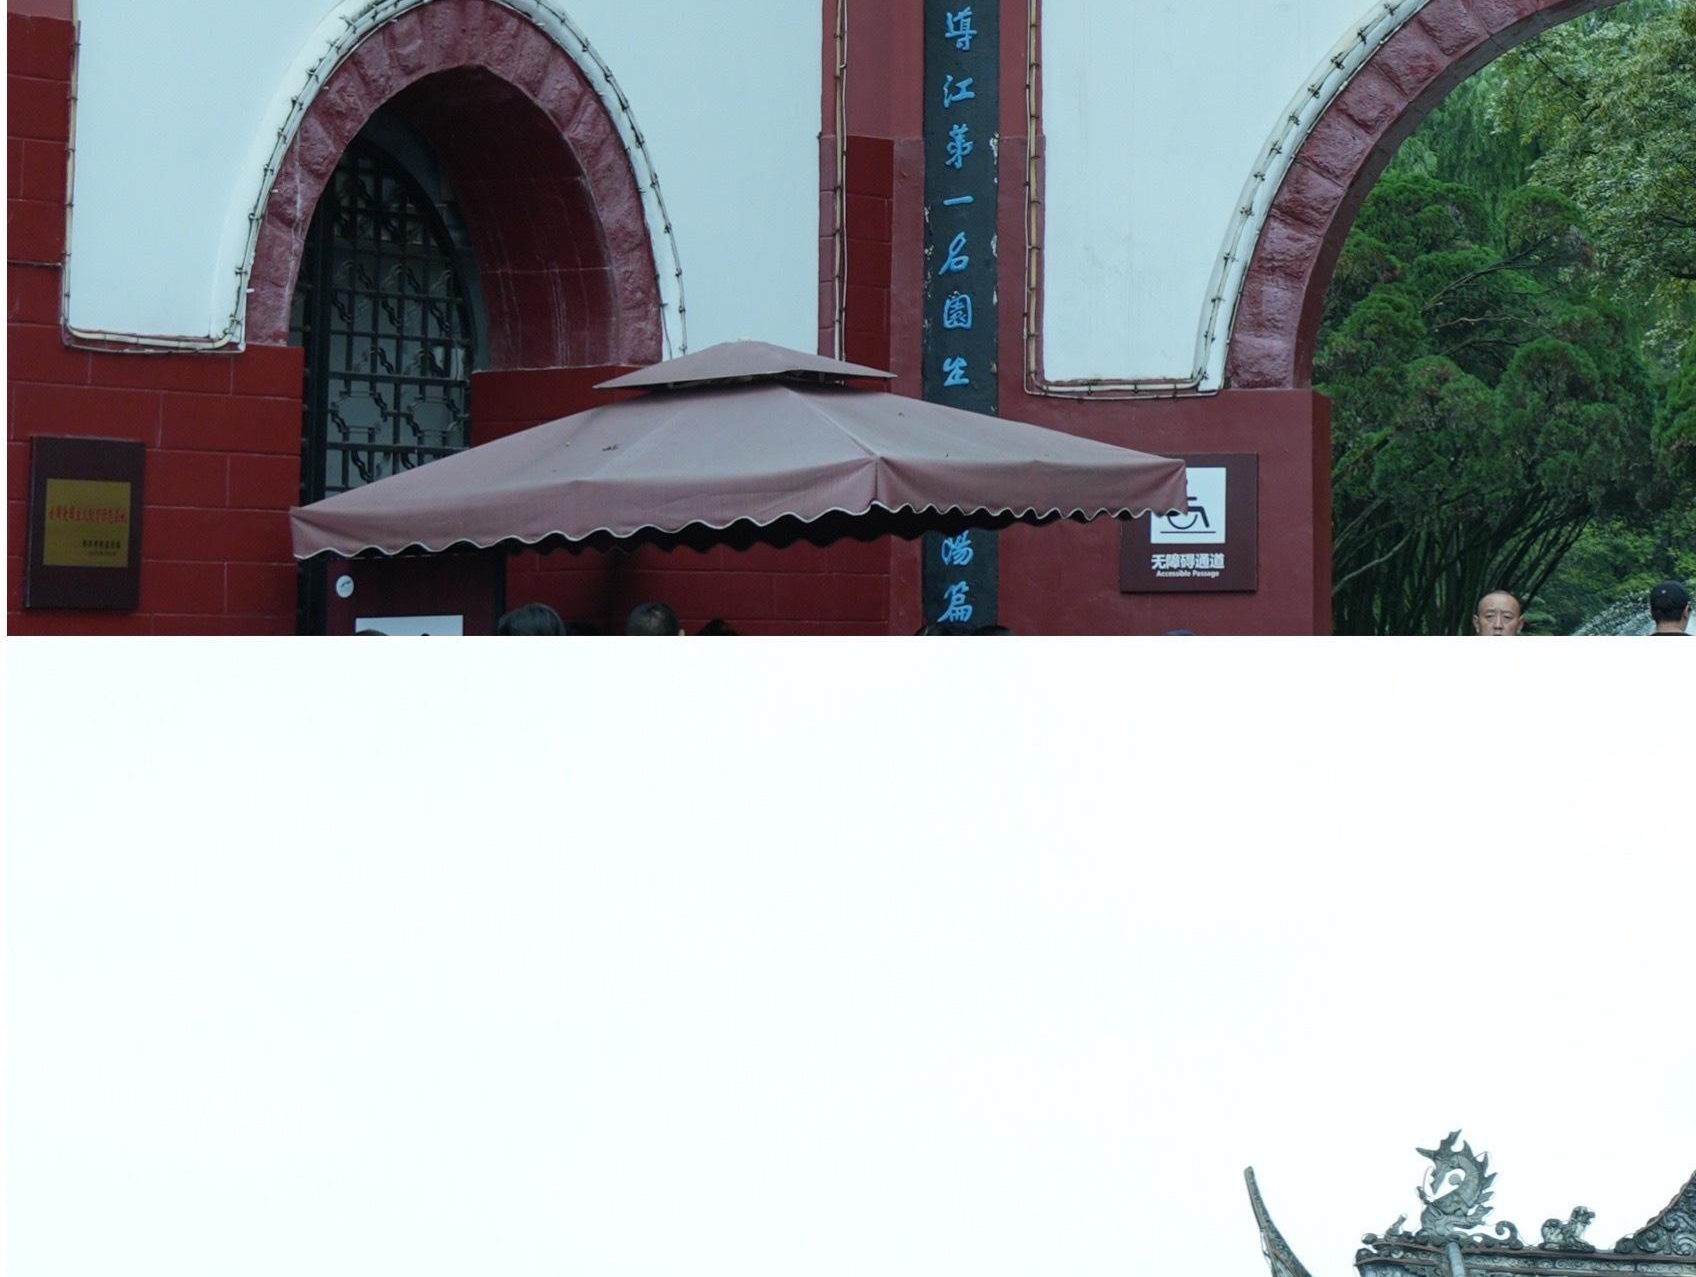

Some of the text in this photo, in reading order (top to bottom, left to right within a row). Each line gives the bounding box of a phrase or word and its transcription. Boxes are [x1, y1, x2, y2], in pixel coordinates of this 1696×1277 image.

[1151, 552, 1225, 570] 无障碍通道
[1156, 570, 1219, 579] Accessible Passage
